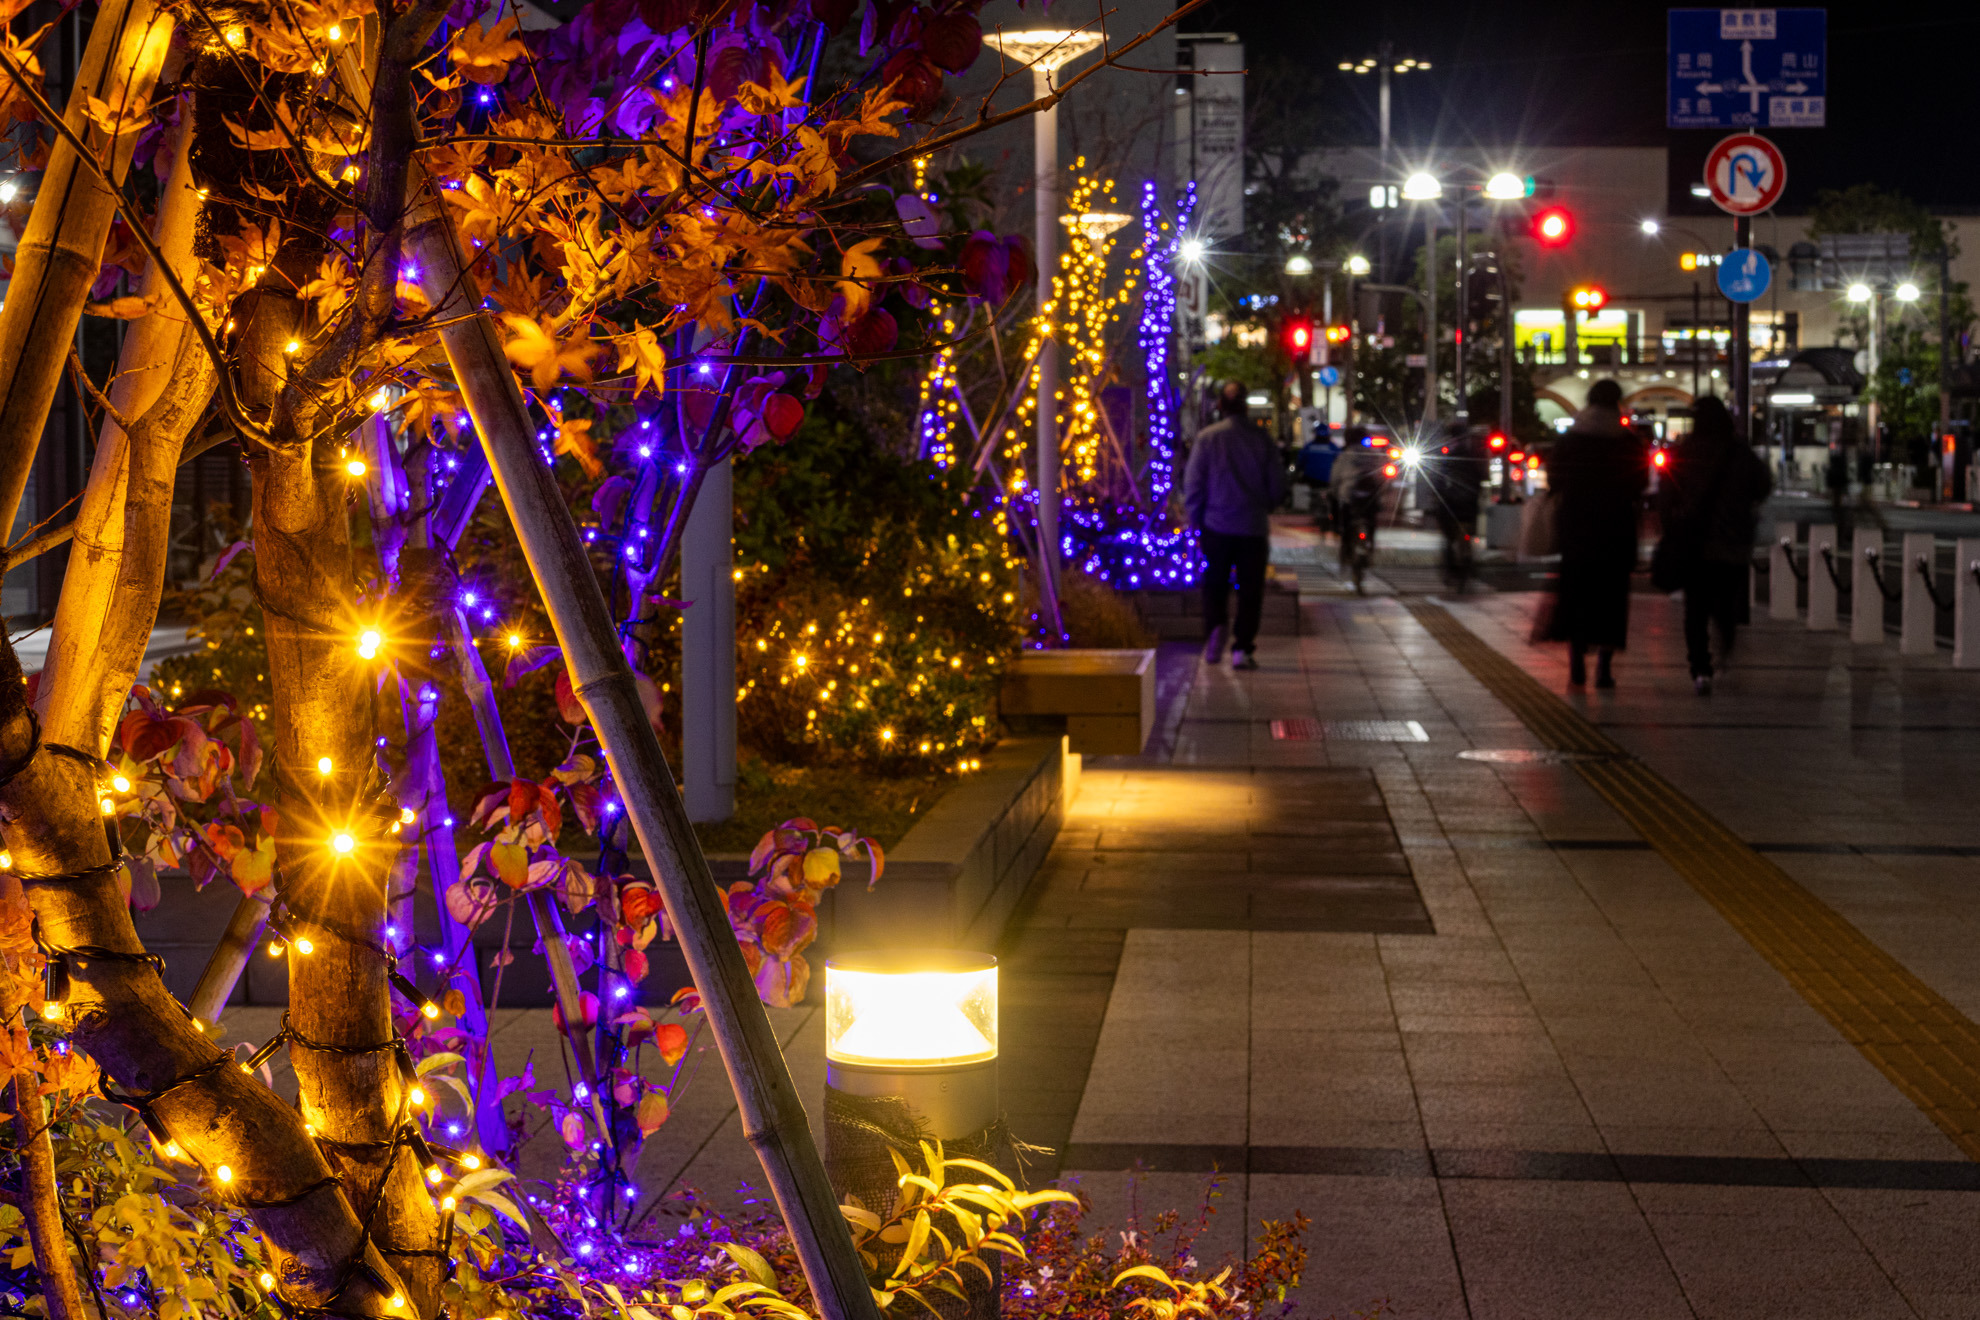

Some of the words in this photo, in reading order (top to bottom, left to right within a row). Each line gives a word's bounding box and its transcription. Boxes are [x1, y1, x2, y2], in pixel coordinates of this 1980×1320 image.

[1725, 13, 1772, 26] 倉敷駅
[1782, 52, 1818, 69] 岡山
